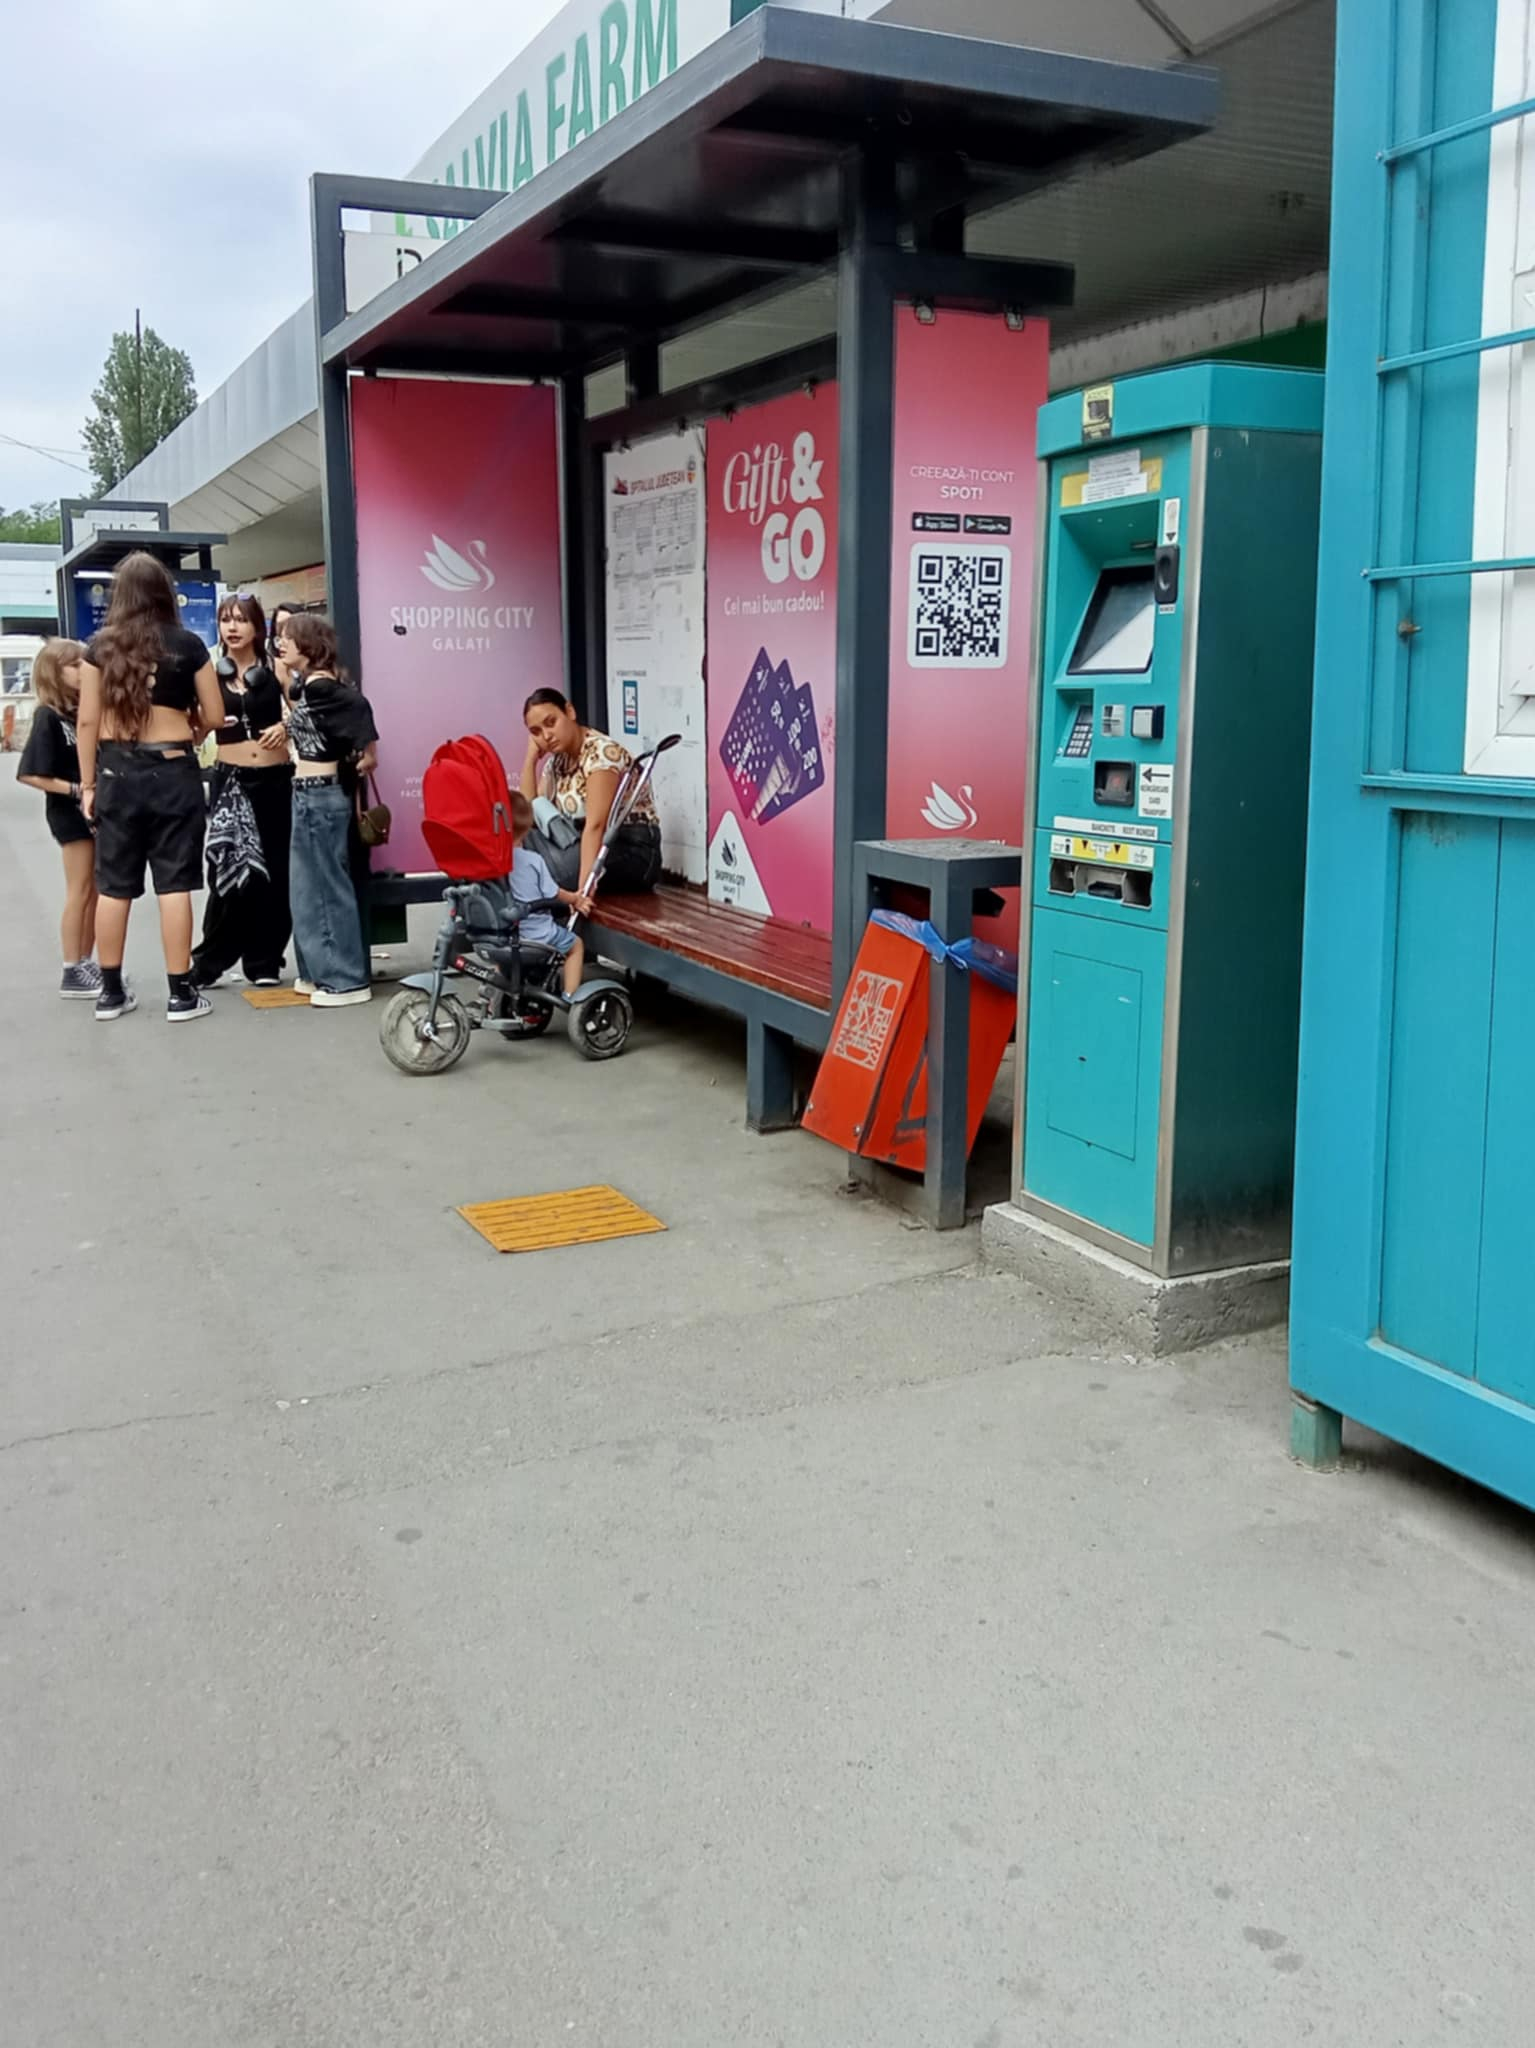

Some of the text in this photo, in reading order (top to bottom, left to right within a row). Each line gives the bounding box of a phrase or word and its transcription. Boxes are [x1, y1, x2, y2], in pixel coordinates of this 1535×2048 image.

[545, 0, 677, 165] FARM
[723, 431, 824, 526] Gift &
[980, 470, 1015, 482] CONT
[940, 485, 983, 500] SPOT!
[761, 507, 826, 583] GO
[724, 590, 824, 616] Cel mai bun cadou!
[390, 606, 534, 629] SHOPPING CITY
